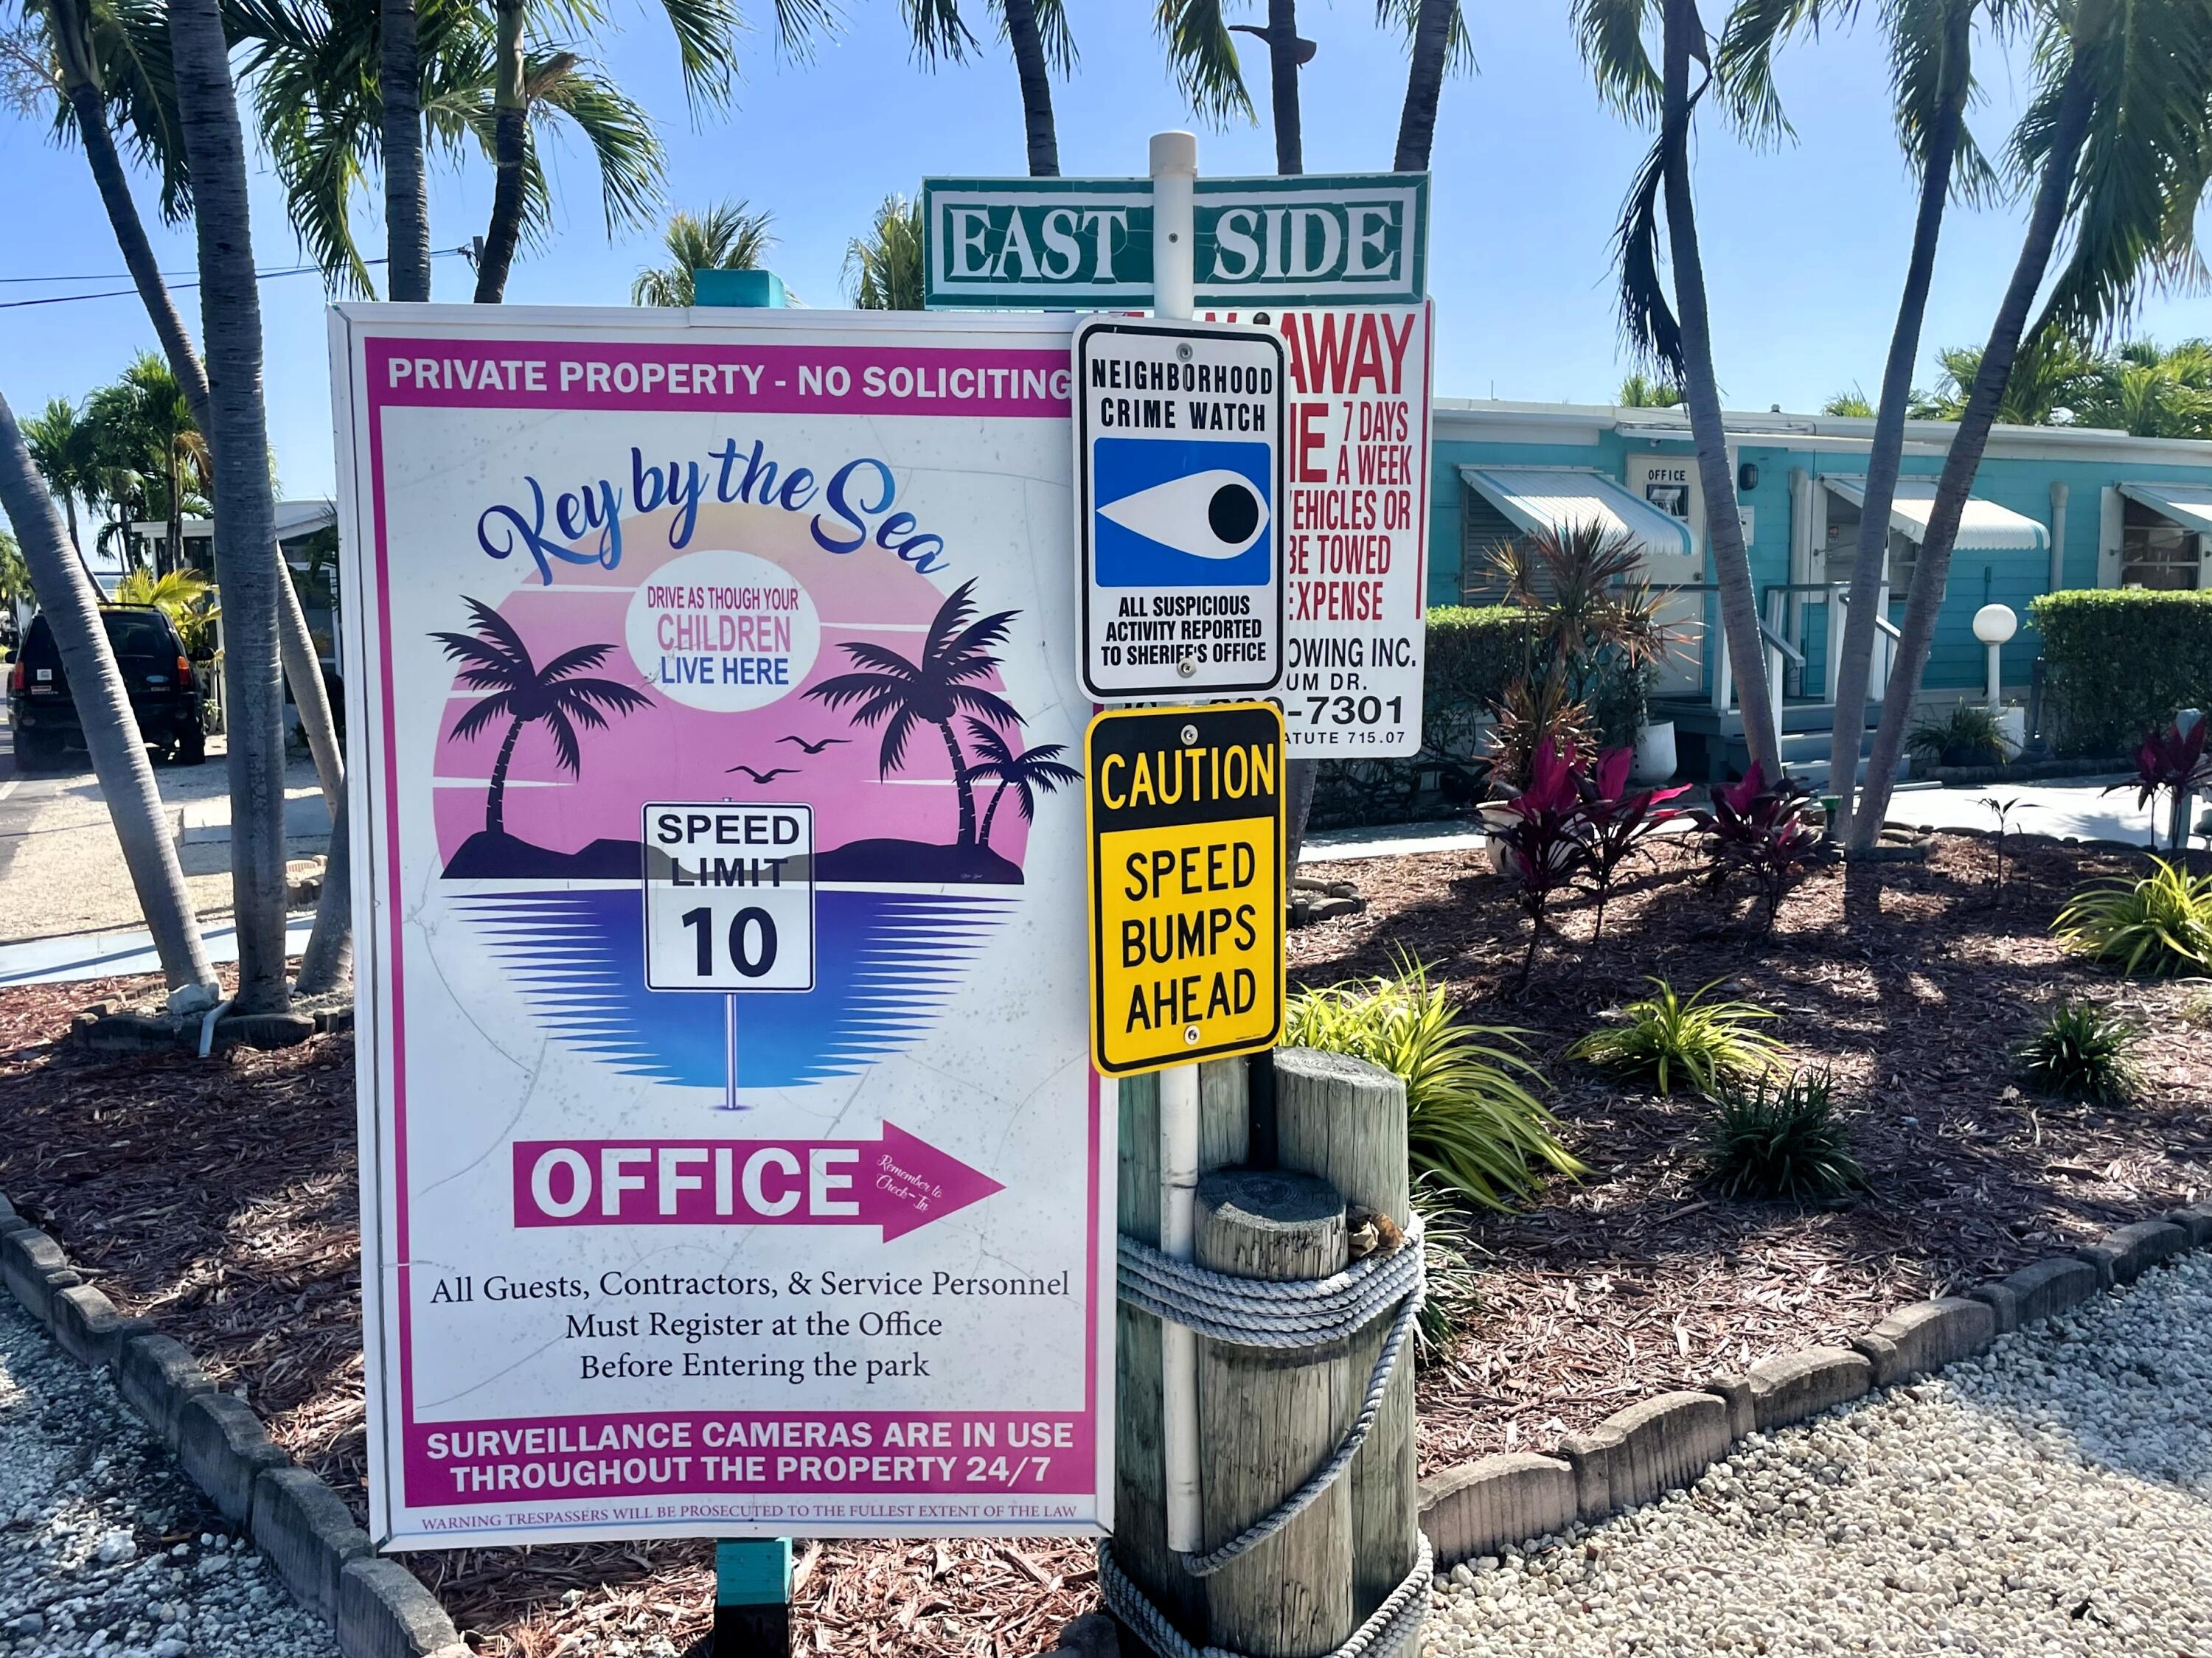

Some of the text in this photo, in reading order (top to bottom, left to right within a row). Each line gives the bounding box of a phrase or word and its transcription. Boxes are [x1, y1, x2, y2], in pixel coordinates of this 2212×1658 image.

[950, 203, 1395, 280] EAST SIDE
[388, 358, 547, 391] PRIVATE
[560, 362, 765, 395] PROPERTY
[799, 366, 851, 397] NO
[863, 367, 1072, 399] SOLICITING
[1092, 359, 1273, 395] NEIGHBORHOOD
[1101, 398, 1265, 432] CRIME WATCH
[1343, 401, 1408, 442] 7 DAYS
[1336, 445, 1412, 484] A WEEK
[1648, 470, 1686, 481] OFFICE
[477, 438, 950, 587] Key by the Sea
[1290, 490, 1411, 530] EHICLES OR
[1317, 534, 1391, 574] TOWED
[647, 585, 799, 610] DRIVE AS THOUGH YOUR
[1119, 595, 1251, 617] ALL SUSPICIOUS
[657, 613, 791, 652] CHILDREN
[1105, 619, 1262, 641] ACTIVITY REPORTED
[661, 656, 789, 685] LIVE HERE
[1101, 642, 1267, 666] TO SHERIFF'S OFFICE
[1289, 638, 1416, 667] OWING INC.
[1286, 673, 1367, 691] UM DR.
[1284, 731, 1405, 745] ATUTE 715.07
[1101, 743, 1275, 809] CAUTION
[657, 814, 799, 846] SPEED
[671, 857, 789, 888] LIMIT
[1124, 841, 1256, 902] SPEED
[681, 906, 778, 978] 10
[1122, 905, 1256, 969] BUMPS
[1125, 968, 1256, 1034] AHEAD
[531, 1147, 860, 1219] OFFICE
[876, 1174, 931, 1213] Check-In
[877, 1154, 942, 1198] Remember to
[430, 1270, 1070, 1303] All Guests, Contractors, & Service Personnel
[566, 1310, 942, 1344] Must Register at the Office
[580, 1351, 931, 1384] Before Entering the park
[426, 1421, 1074, 1460] SURVEILLANCE CAMERAS ARE IN USE
[450, 1456, 1051, 1493] THROUGHOUT THE PROPERTY 24/7
[422, 1505, 1077, 1530] WARNING TRESPASSERS WILL BE PROSECUTED TO THE FULLEST EXTENT OF THE LAW
